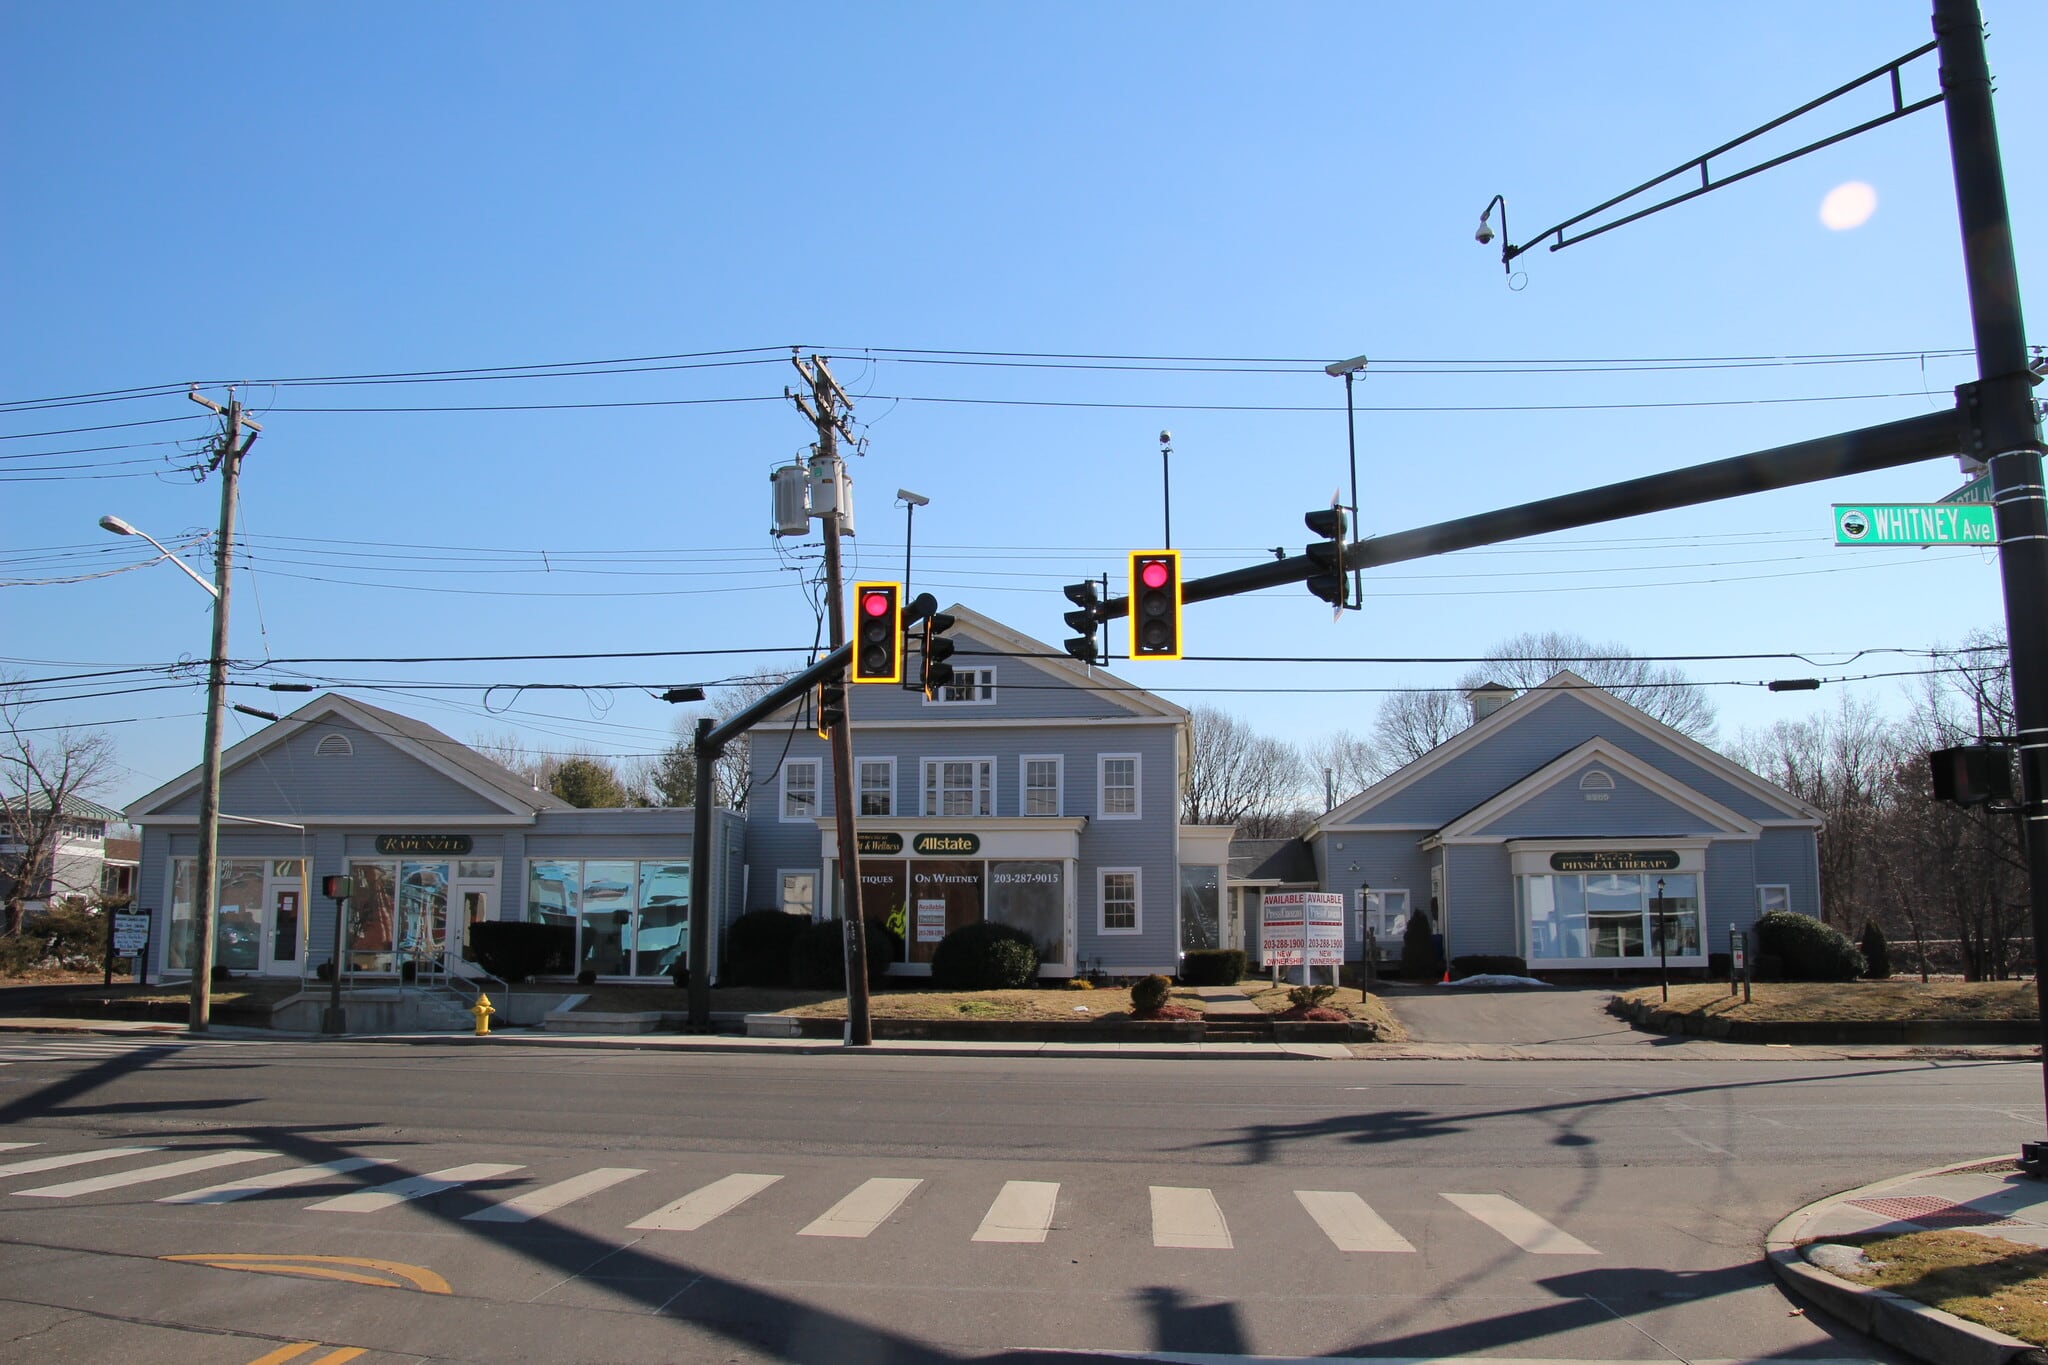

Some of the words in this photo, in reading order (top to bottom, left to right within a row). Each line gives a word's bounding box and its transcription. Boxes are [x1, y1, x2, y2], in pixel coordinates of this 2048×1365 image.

[1873, 508, 1958, 540] WHITNEY
[1962, 519, 1991, 540] Ave
[872, 840, 900, 850] Wellness
[918, 837, 972, 850] Allstate
[1562, 861, 1615, 870] PHYSICAL
[1619, 860, 1668, 869] THERAPY
[994, 874, 1058, 883] 203-287-9015
[1264, 894, 1304, 905] AVAILABLE
[1308, 894, 1342, 904] AVAILABLE
[1264, 938, 1304, 949] 203-288-1900
[1266, 957, 1304, 965] OWNERSHIP
